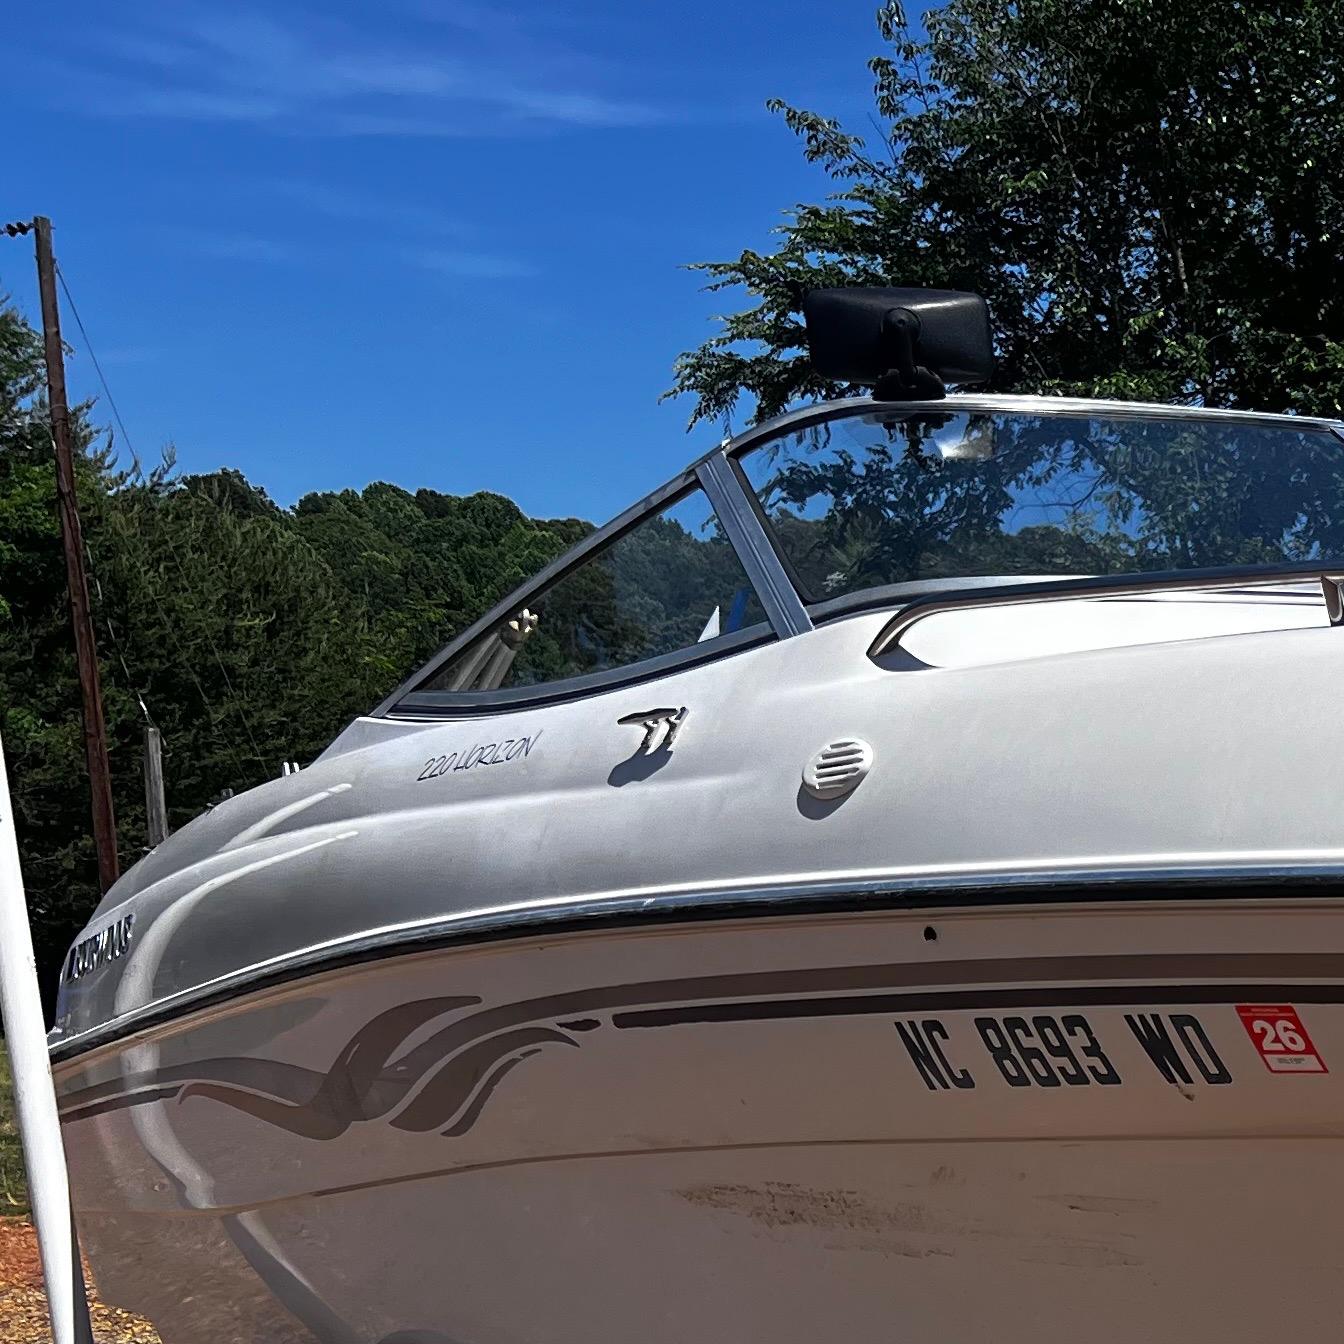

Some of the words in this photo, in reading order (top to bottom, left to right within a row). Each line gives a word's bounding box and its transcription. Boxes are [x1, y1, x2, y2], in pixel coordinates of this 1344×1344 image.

[417, 752, 458, 782] 220
[453, 729, 543, 772] HORIZON
[894, 1020, 976, 1091] NC
[974, 1015, 1122, 1087] 8693
[1123, 1013, 1233, 1086] WD
[1252, 1019, 1306, 1052] 26
